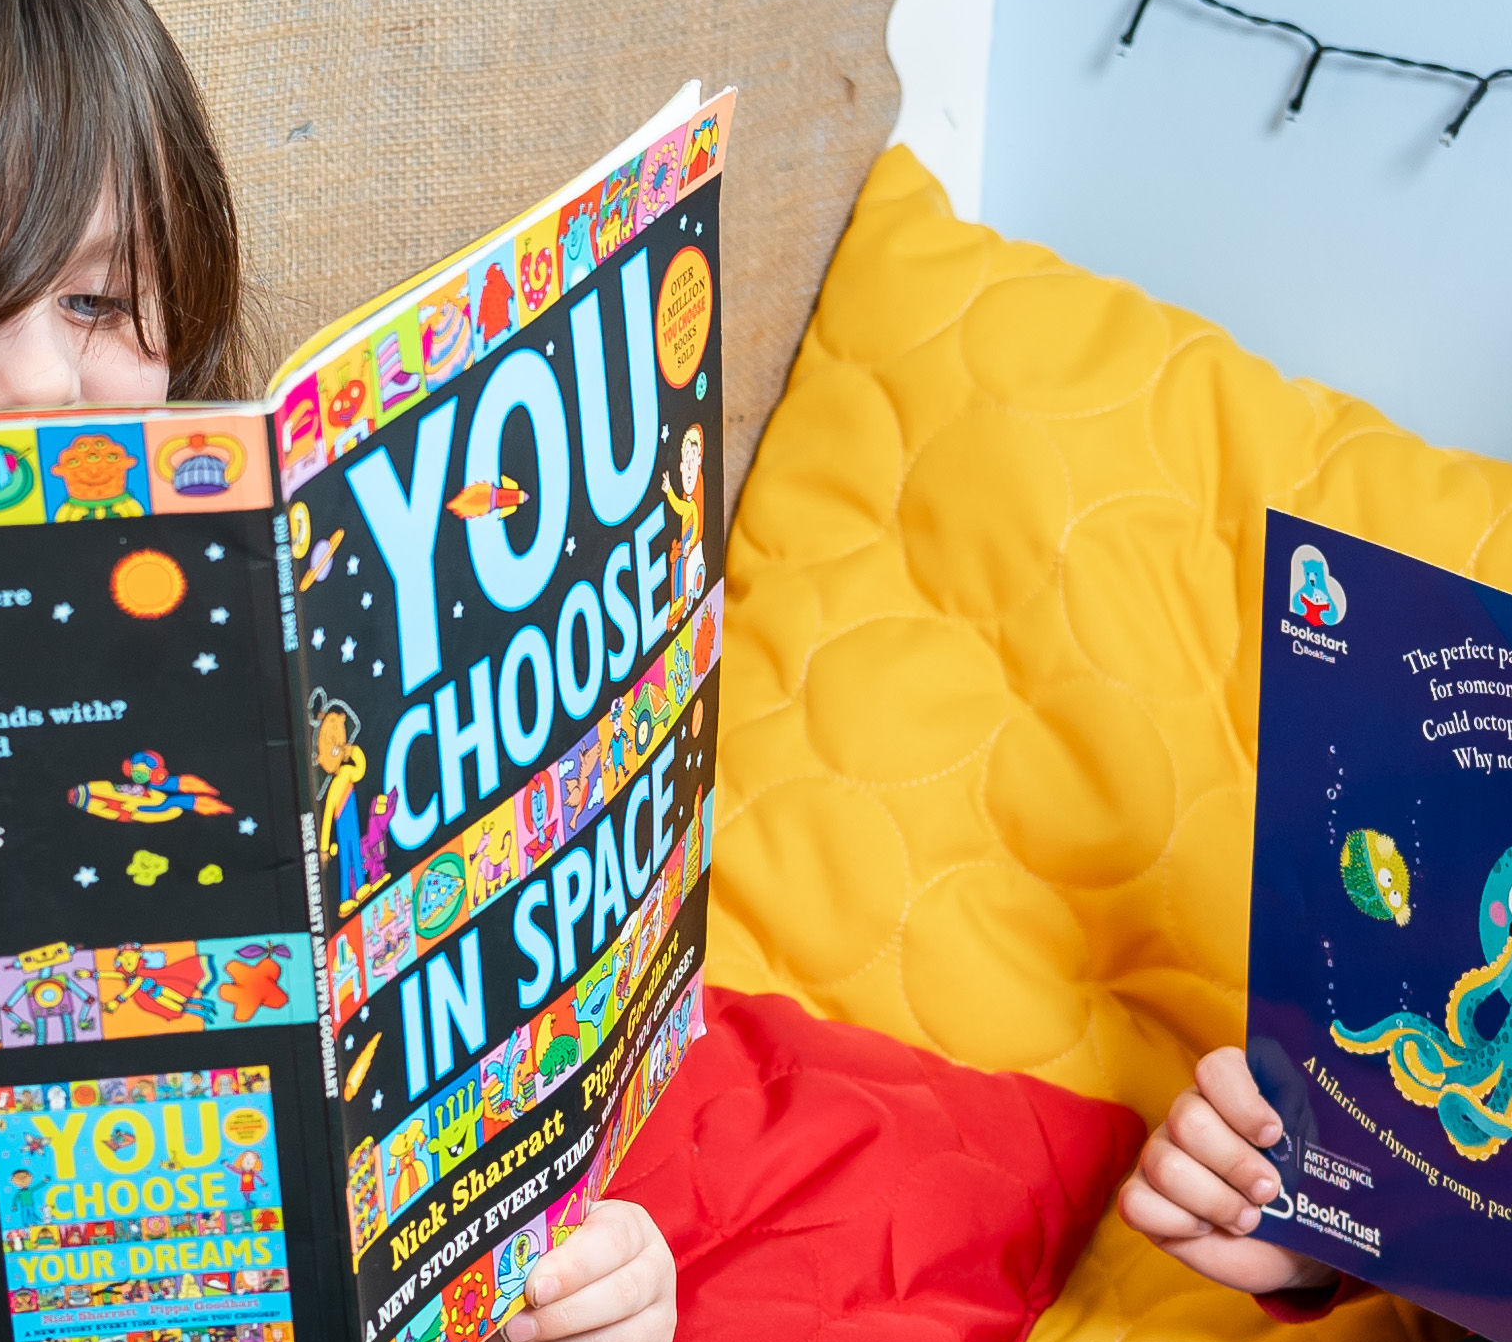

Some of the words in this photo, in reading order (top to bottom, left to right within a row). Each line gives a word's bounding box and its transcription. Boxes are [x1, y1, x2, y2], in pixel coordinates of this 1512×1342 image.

[667, 277, 706, 319] MILLION
[670, 266, 694, 297] OVER
[663, 321, 677, 347] YOU
[679, 295, 706, 333] CHOOSE
[673, 325, 697, 355] BOOKS
[677, 344, 695, 368] SOLD
[344, 246, 661, 699] YOU
[1281, 619, 1348, 655] Bookstart
[1402, 648, 1438, 675] The
[1440, 637, 1494, 671] perfect
[384, 500, 675, 851] CHOOSE
[1429, 678, 1453, 702] for
[1452, 747, 1493, 775] Why
[399, 926, 487, 1103] IN
[512, 735, 677, 1010] SPACE
[582, 1036, 625, 1111] Pippa
[626, 929, 680, 1041] Goodhart
[31, 1101, 222, 1180] YOU
[1302, 1056, 1317, 1074] A
[1315, 1067, 1377, 1135] hilarious
[1377, 1129, 1440, 1187] rhyming
[1442, 1173, 1486, 1212] romp,
[389, 1201, 448, 1272] Nick
[451, 1109, 565, 1216] Sharratt
[1303, 1161, 1351, 1190] ENGLAND
[1304, 1149, 1329, 1169] ARTS
[1331, 1161, 1374, 1189] COUNCIL
[43, 1171, 228, 1221] CHOOSE
[1297, 1192, 1381, 1246] BookTrust
[377, 1274, 418, 1331] NEW
[419, 1217, 482, 1290] STORY
[484, 1167, 550, 1234] EVERY
[553, 1124, 595, 1181] TIME
[19, 1249, 115, 1284] YOUR
[129, 1236, 273, 1275] DREAMS
